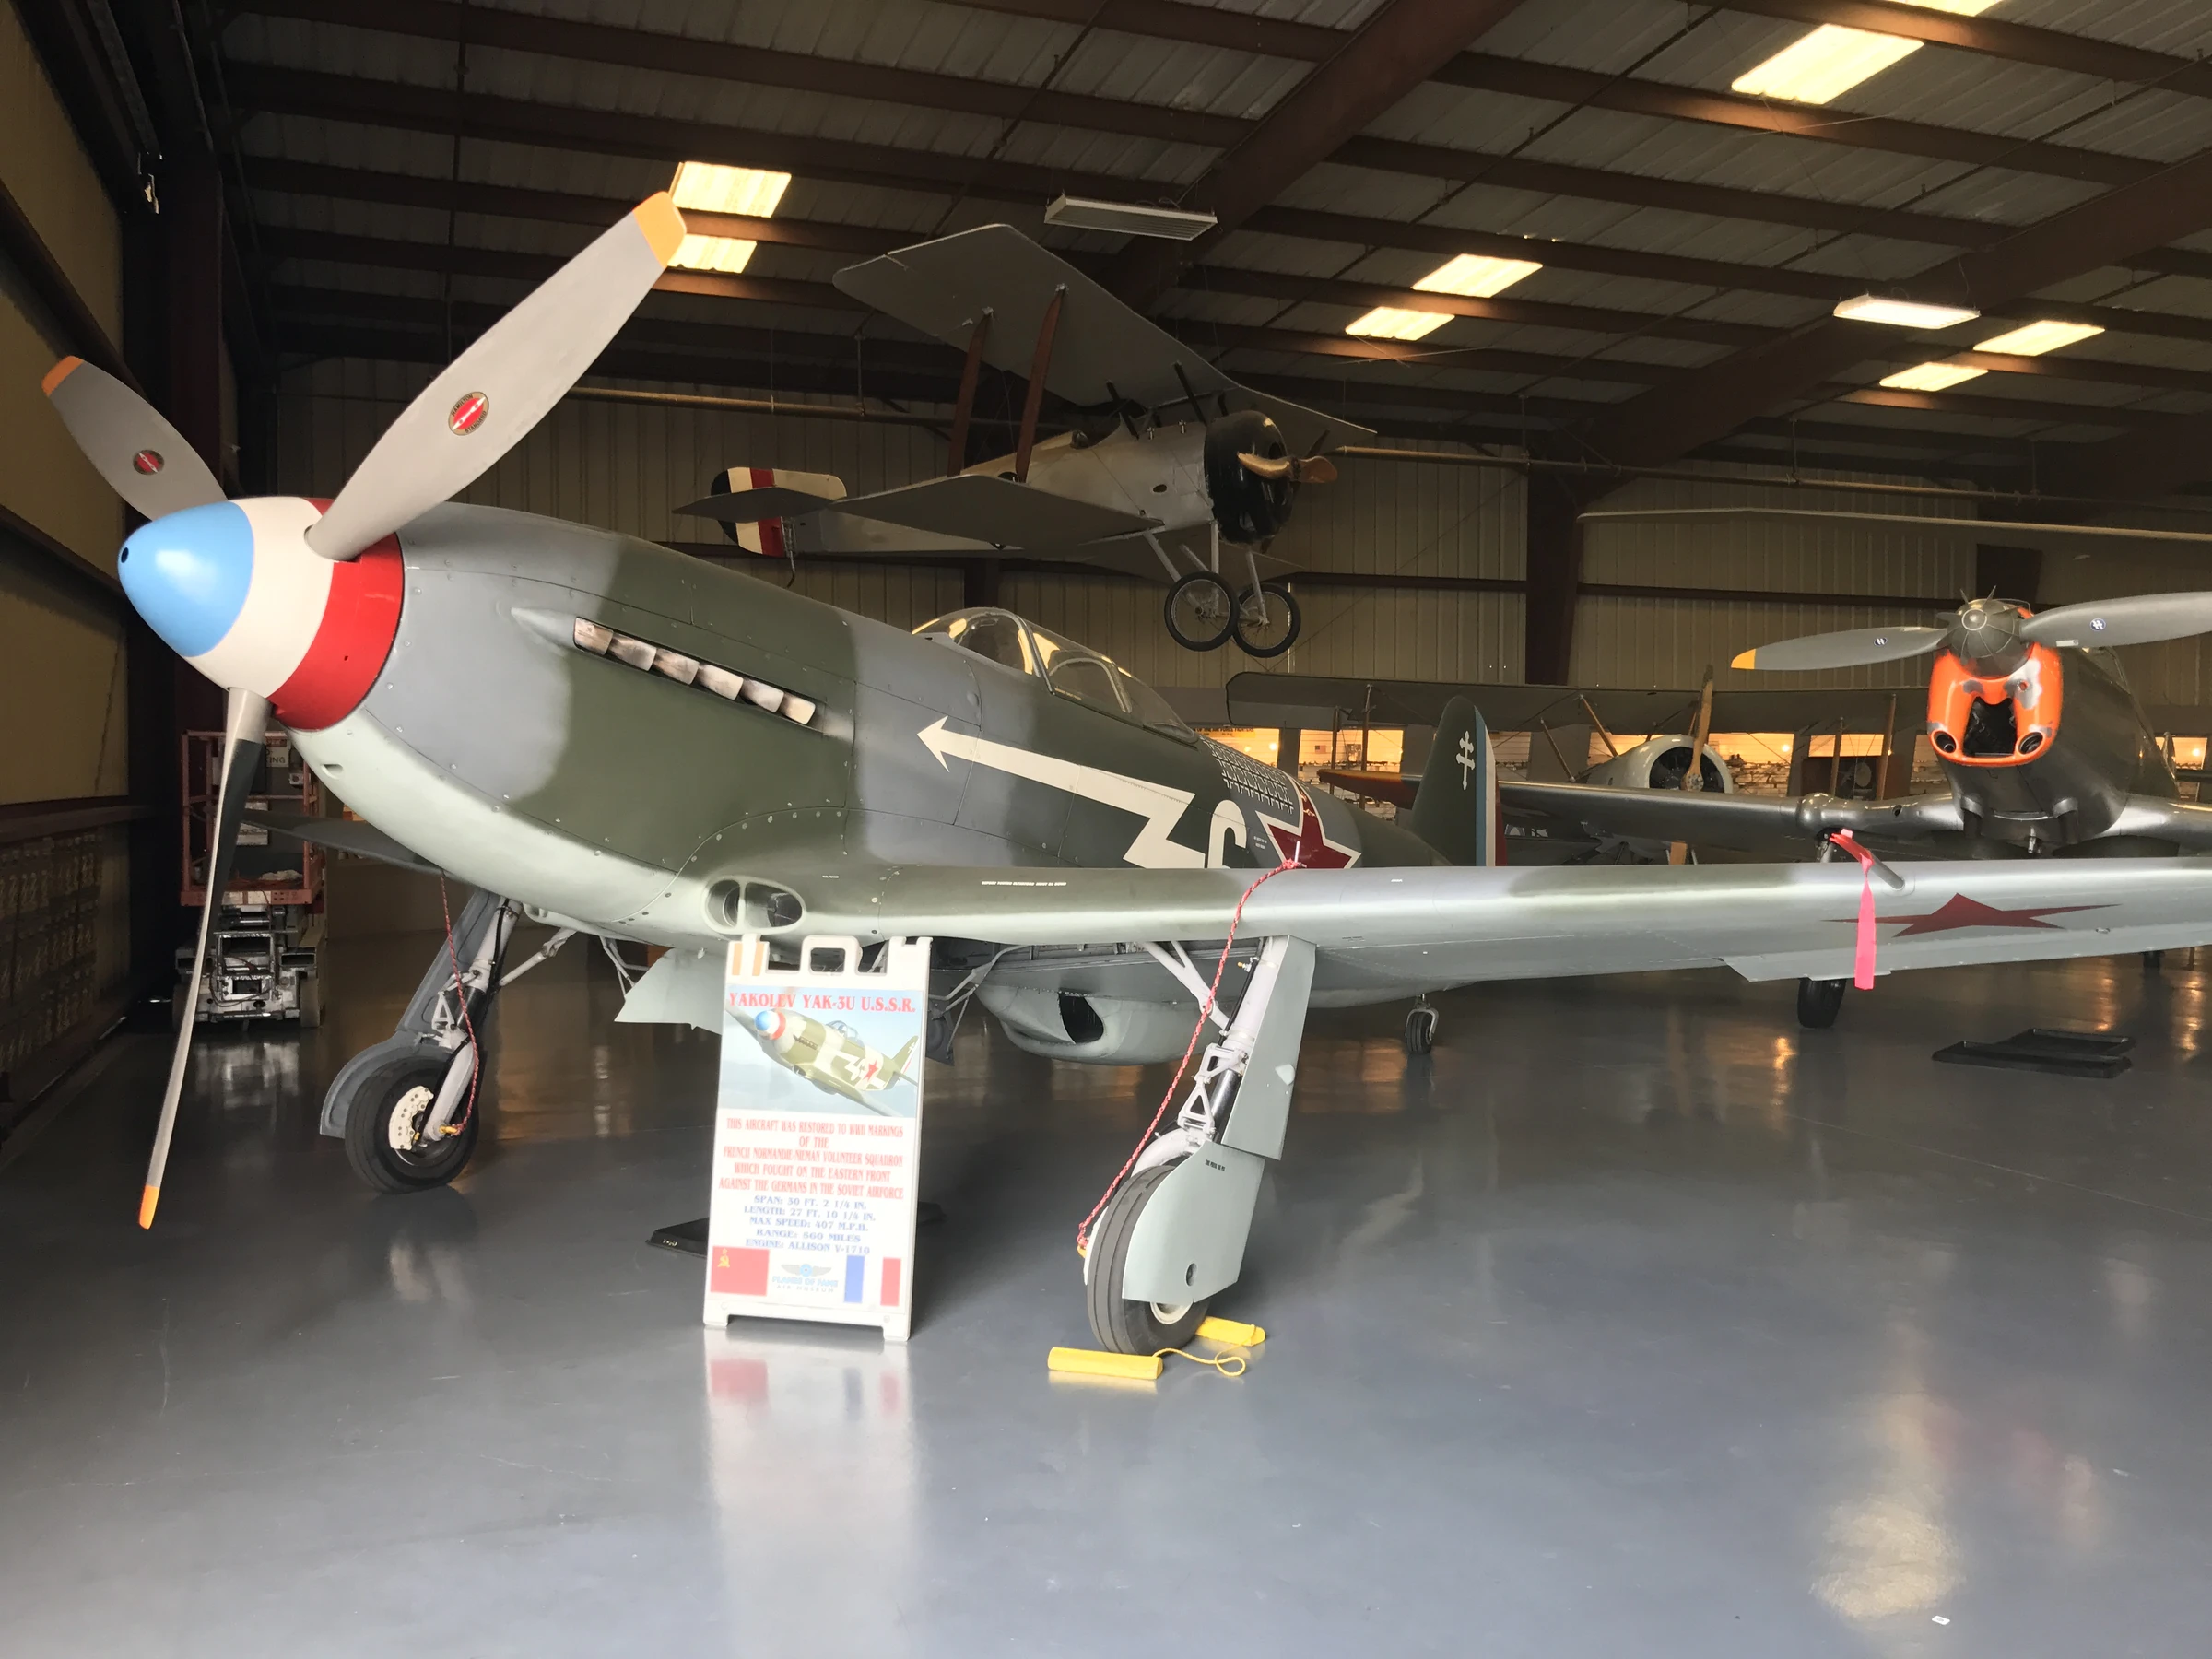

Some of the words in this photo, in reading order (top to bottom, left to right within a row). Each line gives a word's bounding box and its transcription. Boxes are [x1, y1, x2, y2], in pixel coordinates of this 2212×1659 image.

[452, 394, 473, 417] HAMILTON
[465, 410, 486, 433] STANDARD
[729, 993, 796, 1008] YAKOLEV
[803, 994, 855, 1010] YAK-3U
[861, 996, 916, 1012] U.S.S.R.
[727, 1118, 742, 1129] THIS
[745, 1119, 778, 1131] AIRCRAFT
[782, 1121, 796, 1132] WAS
[799, 1121, 834, 1134] RESTORED
[838, 1124, 847, 1135] TO
[850, 1124, 865, 1135] WWII
[868, 1124, 903, 1137] MARKINGS
[799, 1136, 810, 1147] OF
[814, 1136, 830, 1148] THE
[724, 1146, 750, 1159] FRENCH
[753, 1147, 820, 1162] NORMANDIE-NIEMAN
[823, 1150, 862, 1164] VOLUNTEER
[865, 1154, 903, 1168] SQUADRON
[735, 1162, 759, 1174] WHICH
[763, 1164, 794, 1176] FOUGHT
[796, 1166, 807, 1177] ON
[811, 1166, 825, 1178] THE
[829, 1168, 864, 1181] EASTERN
[866, 1169, 891, 1182] FRONT
[719, 1177, 750, 1191] AGAINST
[755, 1179, 769, 1191] THE
[772, 1180, 807, 1193] GERMANS
[810, 1182, 818, 1194] IN
[820, 1182, 834, 1195] THE
[838, 1183, 864, 1197] SOVIET
[866, 1186, 904, 1199] AIRFORCE
[754, 1195, 783, 1205] SPAN:
[805, 1198, 818, 1206] FT.
[823, 1199, 829, 1207] 2
[835, 1199, 850, 1209] 1/4
[854, 1201, 866, 1209] IN.
[744, 1206, 785, 1216] LENGTH:
[790, 1208, 802, 1217] 27
[806, 1208, 820, 1218] FT.
[827, 1210, 838, 1219] 10
[843, 1210, 859, 1221] 1/4
[863, 1213, 876, 1221] IN.
[750, 1217, 771, 1226] MAX
[776, 1218, 810, 1229] SPEED:
[815, 1220, 834, 1230] 407
[838, 1222, 868, 1231] M.P.H.
[757, 1230, 798, 1238] RANGE:
[829, 1232, 861, 1242] MILES
[746, 1239, 784, 1249] ENGINE:
[788, 1241, 830, 1253] ALLISON
[835, 1244, 870, 1254] V-1710
[772, 1276, 802, 1284] PLANES
[818, 1278, 838, 1288] FAME
